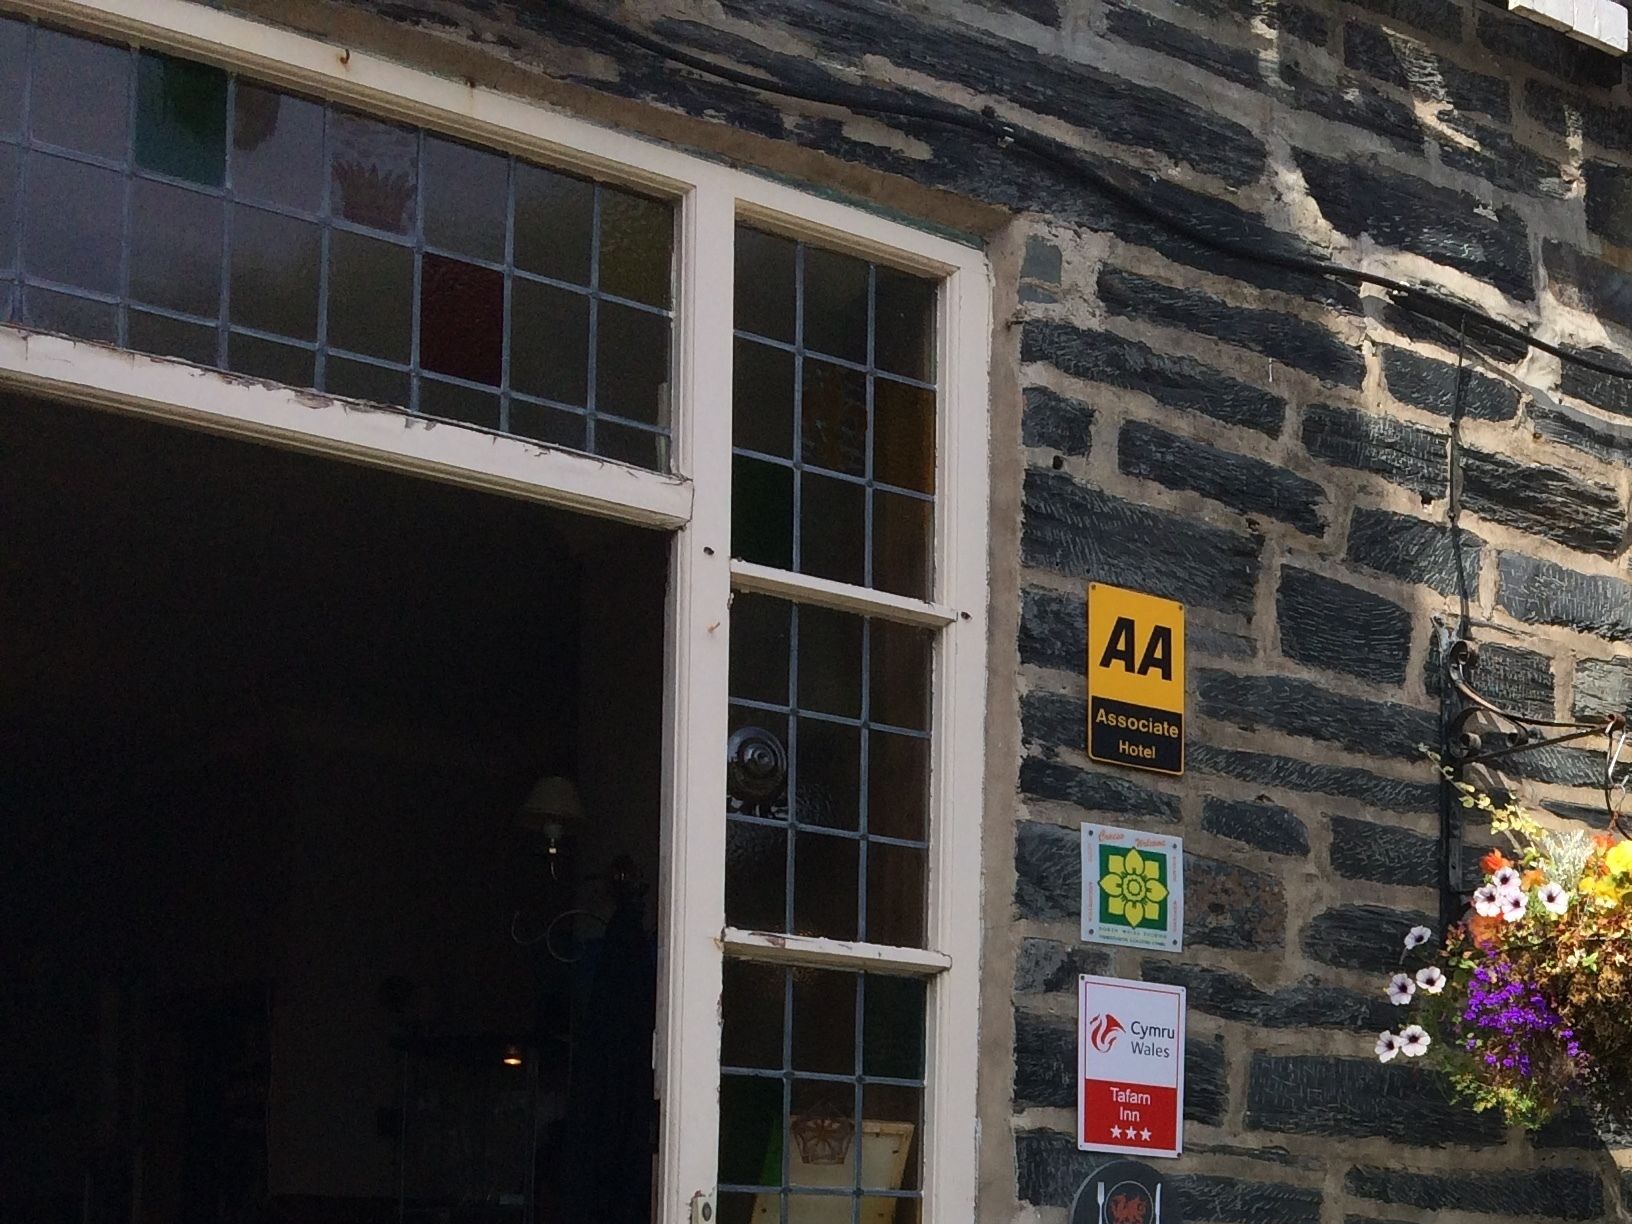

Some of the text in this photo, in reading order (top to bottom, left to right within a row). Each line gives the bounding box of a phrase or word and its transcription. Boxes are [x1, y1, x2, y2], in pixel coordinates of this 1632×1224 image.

[1099, 616, 1172, 681] AA
[1096, 708, 1179, 738] Associate
[1119, 740, 1156, 759] Hotel
[1130, 1021, 1175, 1039] Cymru
[1131, 1041, 1170, 1058] Wales
[1110, 1087, 1151, 1105] Tafarn
[1119, 1106, 1140, 1121] Inn
